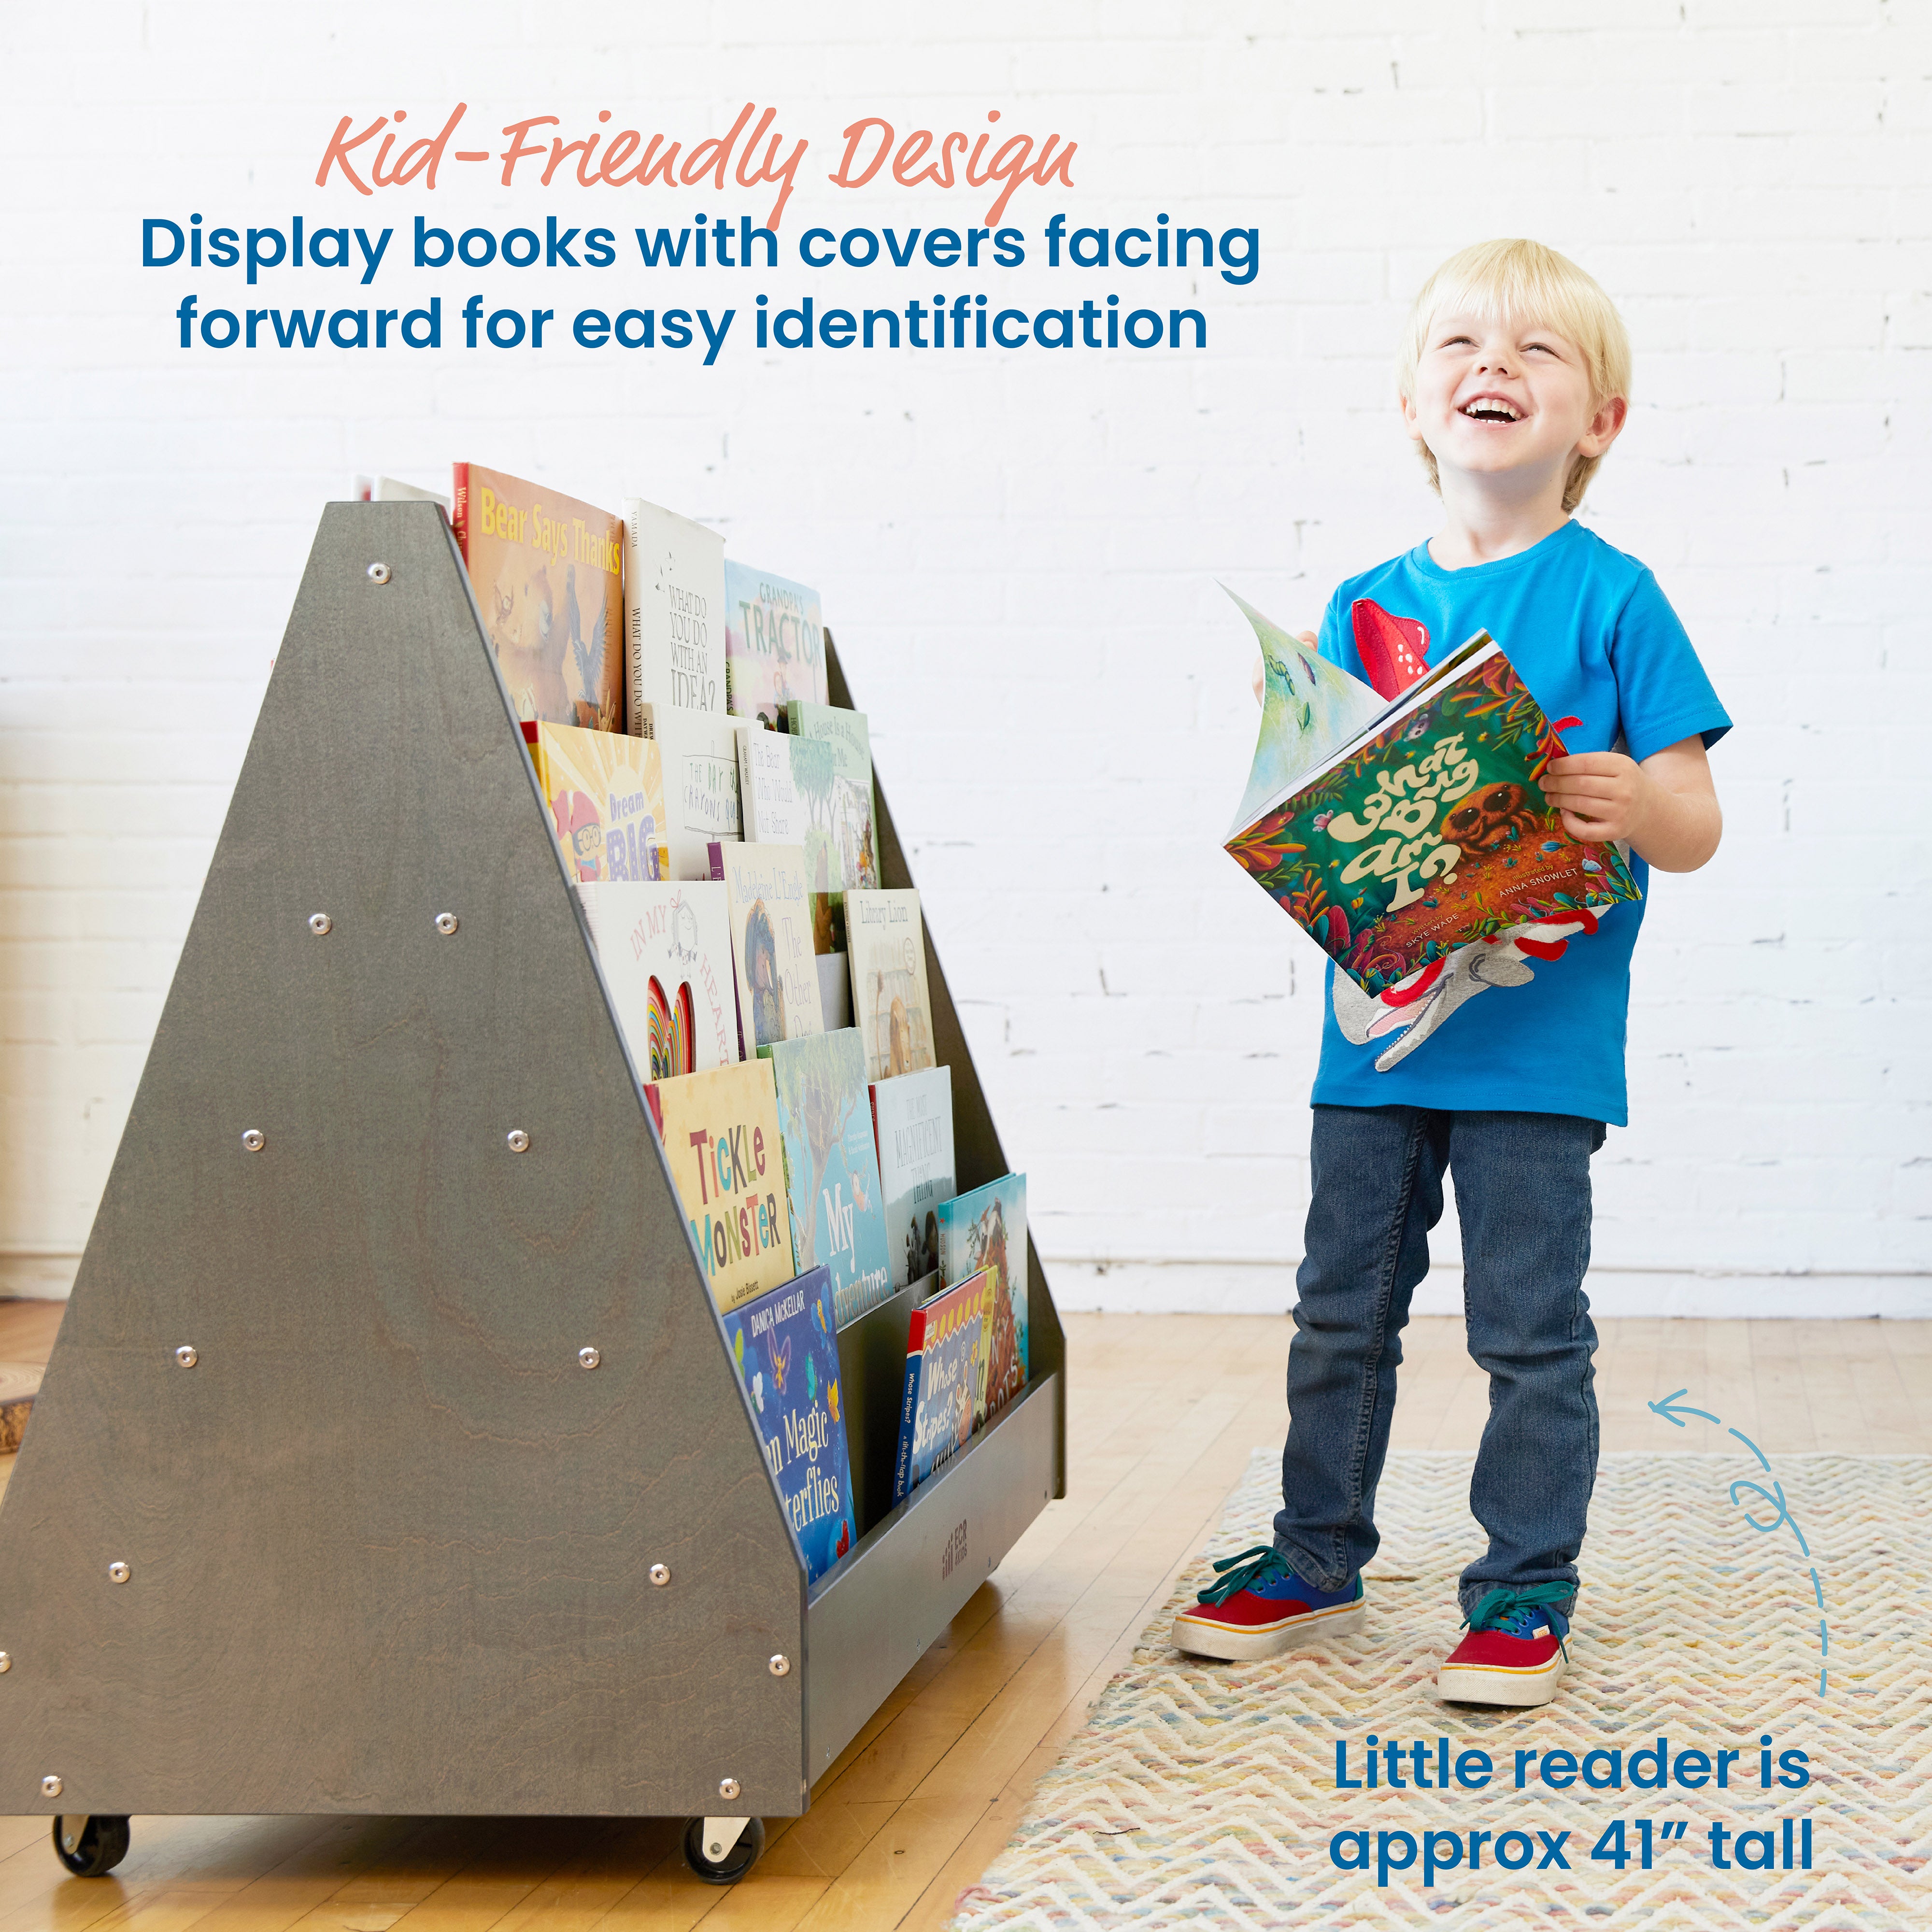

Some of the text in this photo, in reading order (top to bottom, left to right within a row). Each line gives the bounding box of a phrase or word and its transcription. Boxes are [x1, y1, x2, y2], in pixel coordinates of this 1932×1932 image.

[457, 487, 467, 518] Wilson
[482, 487, 527, 544] Bear
[532, 503, 568, 567] Says
[572, 517, 620, 575] Thanks
[669, 584, 707, 619] WHAT DO
[759, 582, 804, 615] GRANDPA'S
[631, 607, 641, 640] WHAT
[670, 611, 707, 648] YOU DO
[739, 600, 822, 668] TRACTOR
[632, 642, 641, 660] DO
[670, 642, 708, 675] WITH AN
[633, 662, 642, 686] YOU
[671, 668, 715, 711] IDEA?
[634, 690, 643, 706] DO
[813, 721, 833, 740] House
[753, 743, 781, 769] The Bear
[690, 762, 703, 783] THE
[708, 762, 724, 794] DAY
[755, 776, 770, 800] Who
[772, 779, 793, 803] Would
[1327, 731, 1468, 843] What
[610, 791, 644, 823] Dream
[683, 784, 720, 822] CRAYONS
[1378, 759, 1479, 839] Bug
[758, 810, 789, 835] Not Share
[606, 814, 660, 881] BIG
[733, 866, 804, 906] Madeleine L'Engle
[1381, 843, 1462, 913] I?
[1499, 868, 1577, 898] ANNA SNOWLET
[860, 900, 908, 930] Library Lion
[1406, 913, 1460, 948] SKYE WADE
[1435, 914, 1443, 922] by
[630, 905, 667, 961] IN MY
[781, 916, 802, 961] The
[785, 964, 811, 1007] Other
[700, 953, 729, 1065] HEART
[895, 1116, 942, 1169] MAGNIFICENT
[911, 1162, 933, 1204] THING
[822, 1182, 856, 1274] My
[736, 1286, 746, 1300] Josie
[746, 1280, 759, 1295] Bissett
[751, 1290, 805, 1338] DANICA McKELLAR
[927, 1356, 958, 1401] Whose
[904, 1396, 913, 1424] Stripes?
[912, 1391, 953, 1454] Stripes?
[783, 1400, 829, 1464] Magic
[896, 1479, 905, 1498] book
[954, 1519, 967, 1550] ECR
